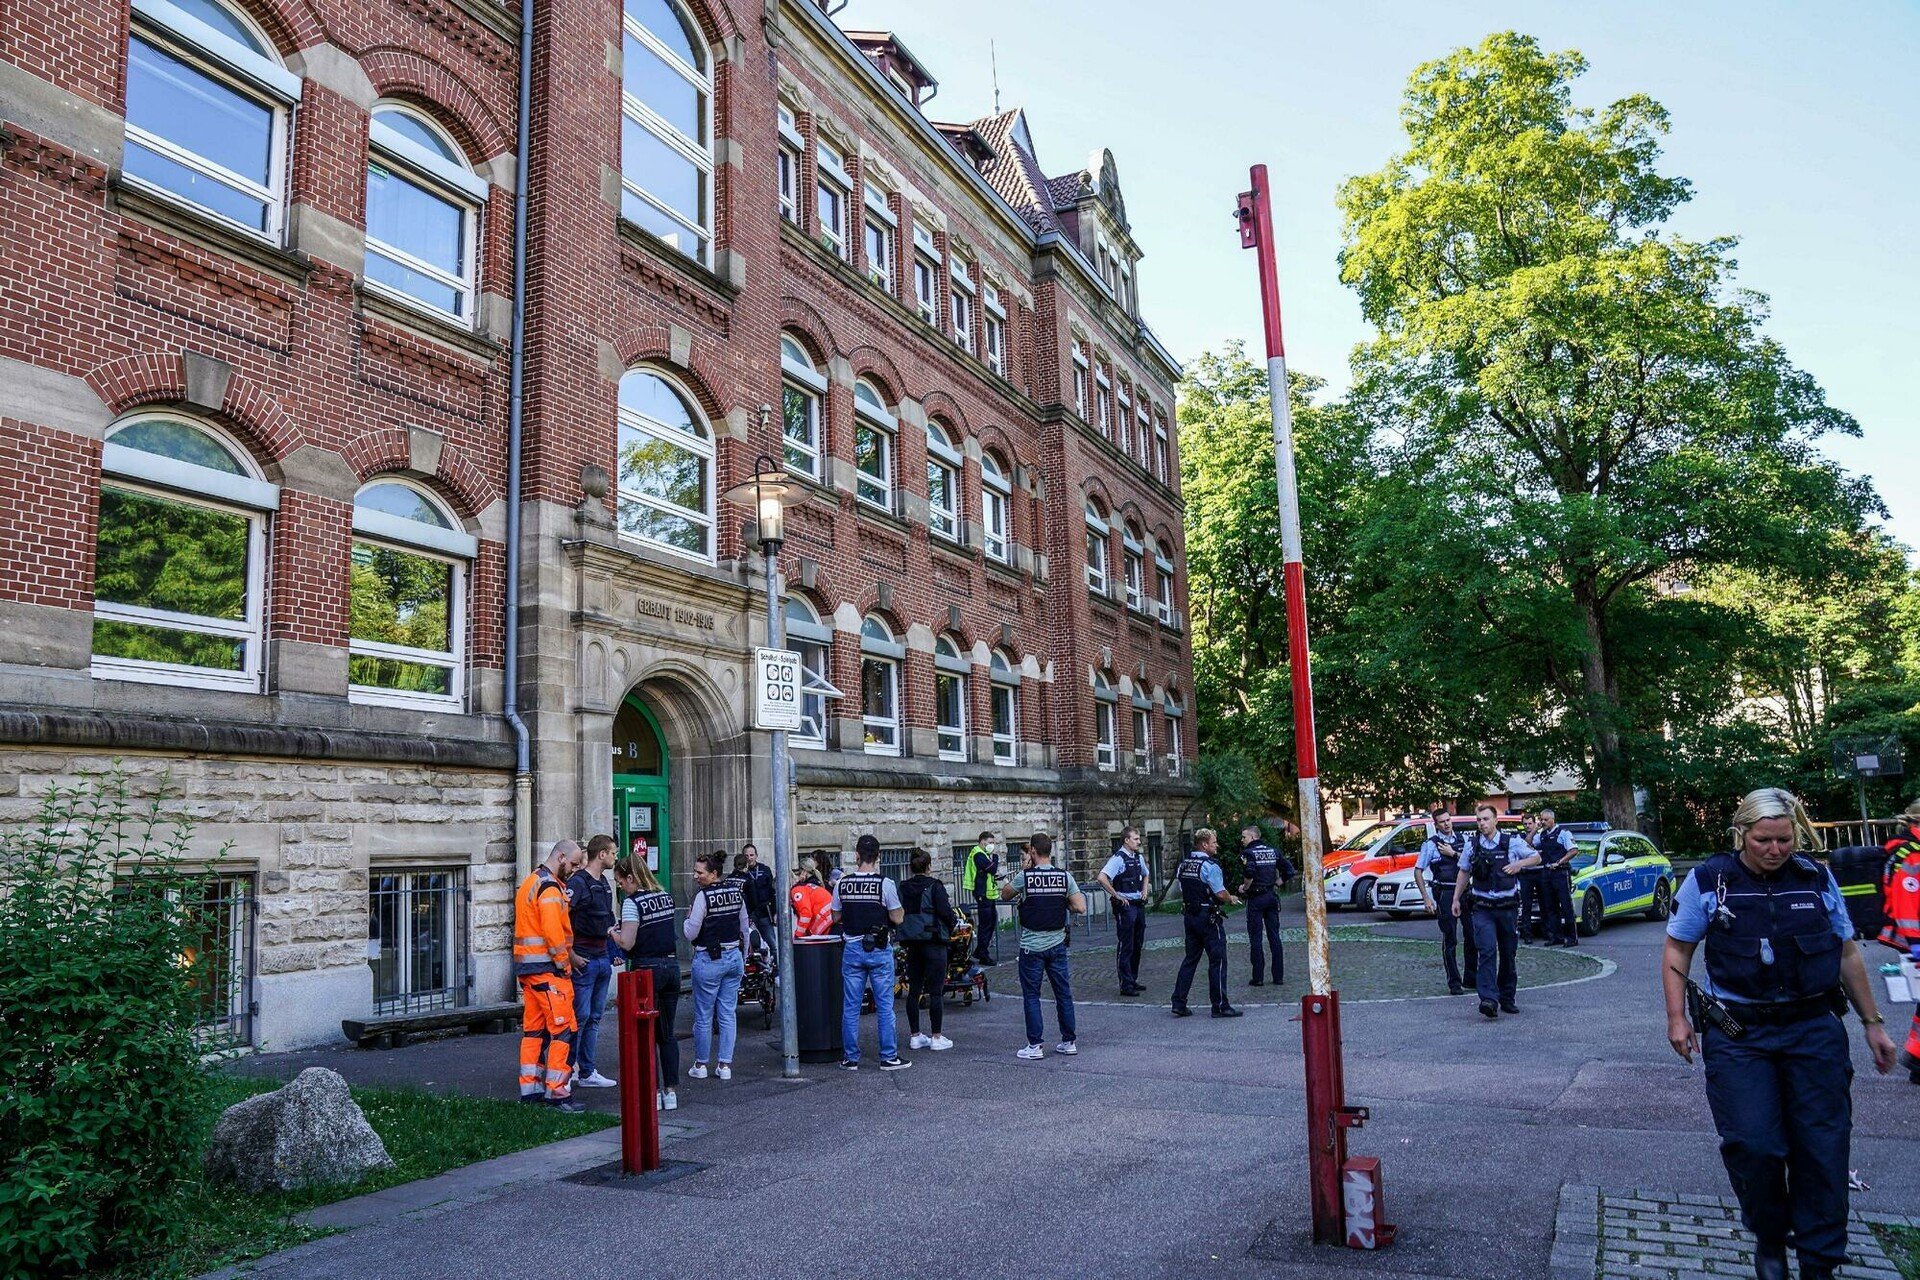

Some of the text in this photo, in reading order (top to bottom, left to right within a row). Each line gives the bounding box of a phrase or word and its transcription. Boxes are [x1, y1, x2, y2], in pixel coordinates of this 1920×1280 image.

[638, 599, 671, 620] ERBAUT
[611, 741, 637, 758] us B
[1027, 876, 1066, 887] POLIZEI
[1613, 879, 1633, 891] POLIZEI
[840, 882, 879, 894] POLIZEI
